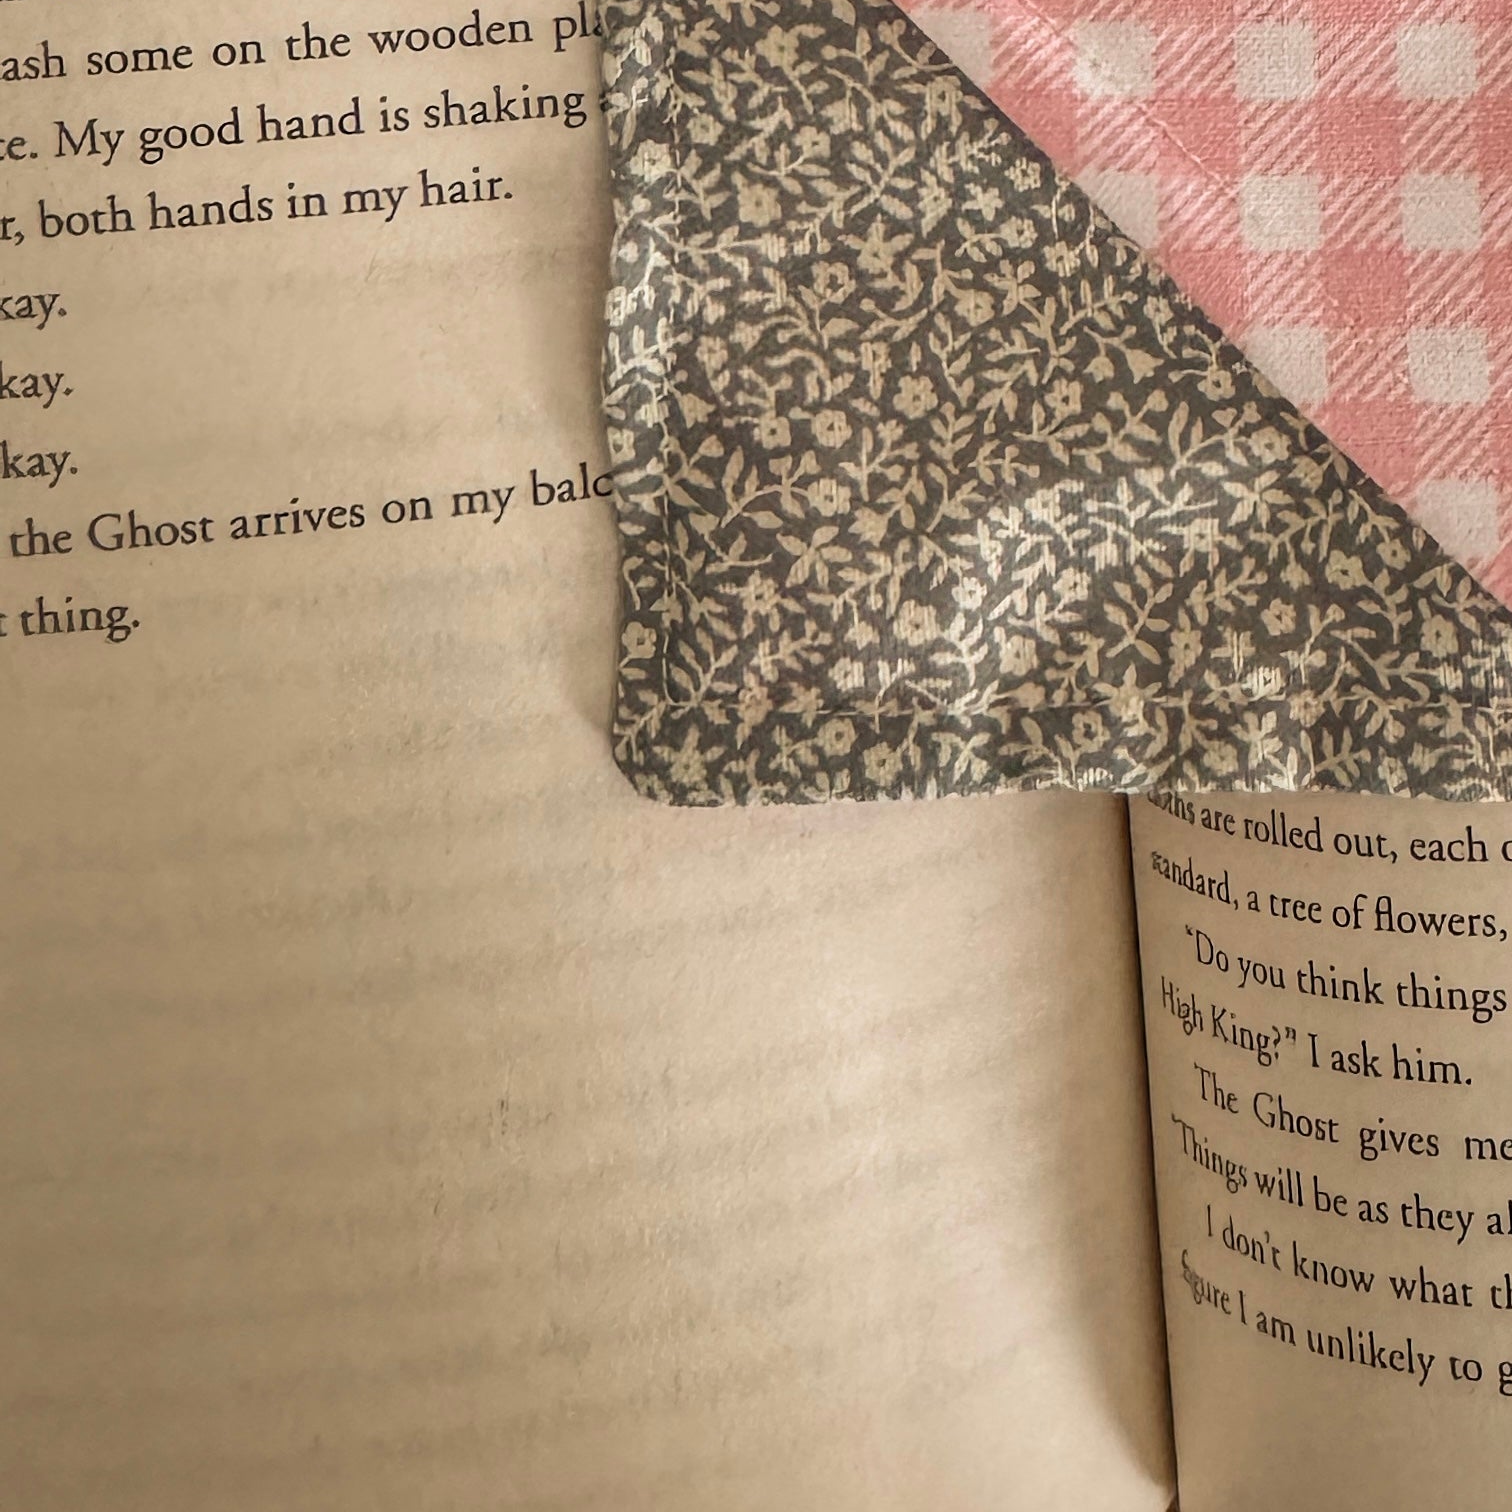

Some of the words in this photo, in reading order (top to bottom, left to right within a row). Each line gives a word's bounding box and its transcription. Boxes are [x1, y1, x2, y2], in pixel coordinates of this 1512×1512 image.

[53, 118, 124, 166] My
[140, 106, 244, 164] good
[256, 96, 365, 143] hand
[380, 96, 409, 132] is
[424, 83, 588, 129] shaking
[38, 195, 135, 238] both
[147, 184, 273, 230] hands
[288, 183, 328, 218] in
[342, 186, 408, 222] my
[418, 167, 512, 207] hair.
[9, 518, 72, 557] the
[87, 510, 214, 551] Ghost
[230, 498, 365, 540] arrives
[382, 497, 433, 523] on
[451, 486, 515, 524] my
[20, 596, 139, 643] thing.
[1200, 808, 1236, 836] are
[1243, 808, 1325, 853] rolled
[1334, 834, 1397, 864] out,
[1410, 825, 1488, 862] each
[1246, 890, 1261, 913] a
[1270, 894, 1322, 923] tree
[1332, 895, 1363, 931] of
[1373, 895, 1508, 942] flowers,
[1237, 957, 1286, 989] you
[1297, 960, 1384, 1004] think
[1397, 972, 1507, 1024] things
[1161, 976, 1204, 1036] High
[1308, 1033, 1319, 1067] I
[1331, 1040, 1382, 1077] ask
[1392, 1043, 1471, 1085] him.
[1254, 1167, 1304, 1207] will
[1313, 1175, 1348, 1216] be
[1358, 1200, 1388, 1224] as
[1401, 1193, 1474, 1245] they
[1207, 1205, 1212, 1237] I
[1223, 1215, 1280, 1270] don’t
[1293, 1241, 1374, 1292] know
[1389, 1265, 1473, 1307] what
[1239, 1290, 1247, 1325] I
[1255, 1312, 1297, 1346] am
[1307, 1326, 1435, 1387] unlikely
[1449, 1357, 1482, 1381] to
